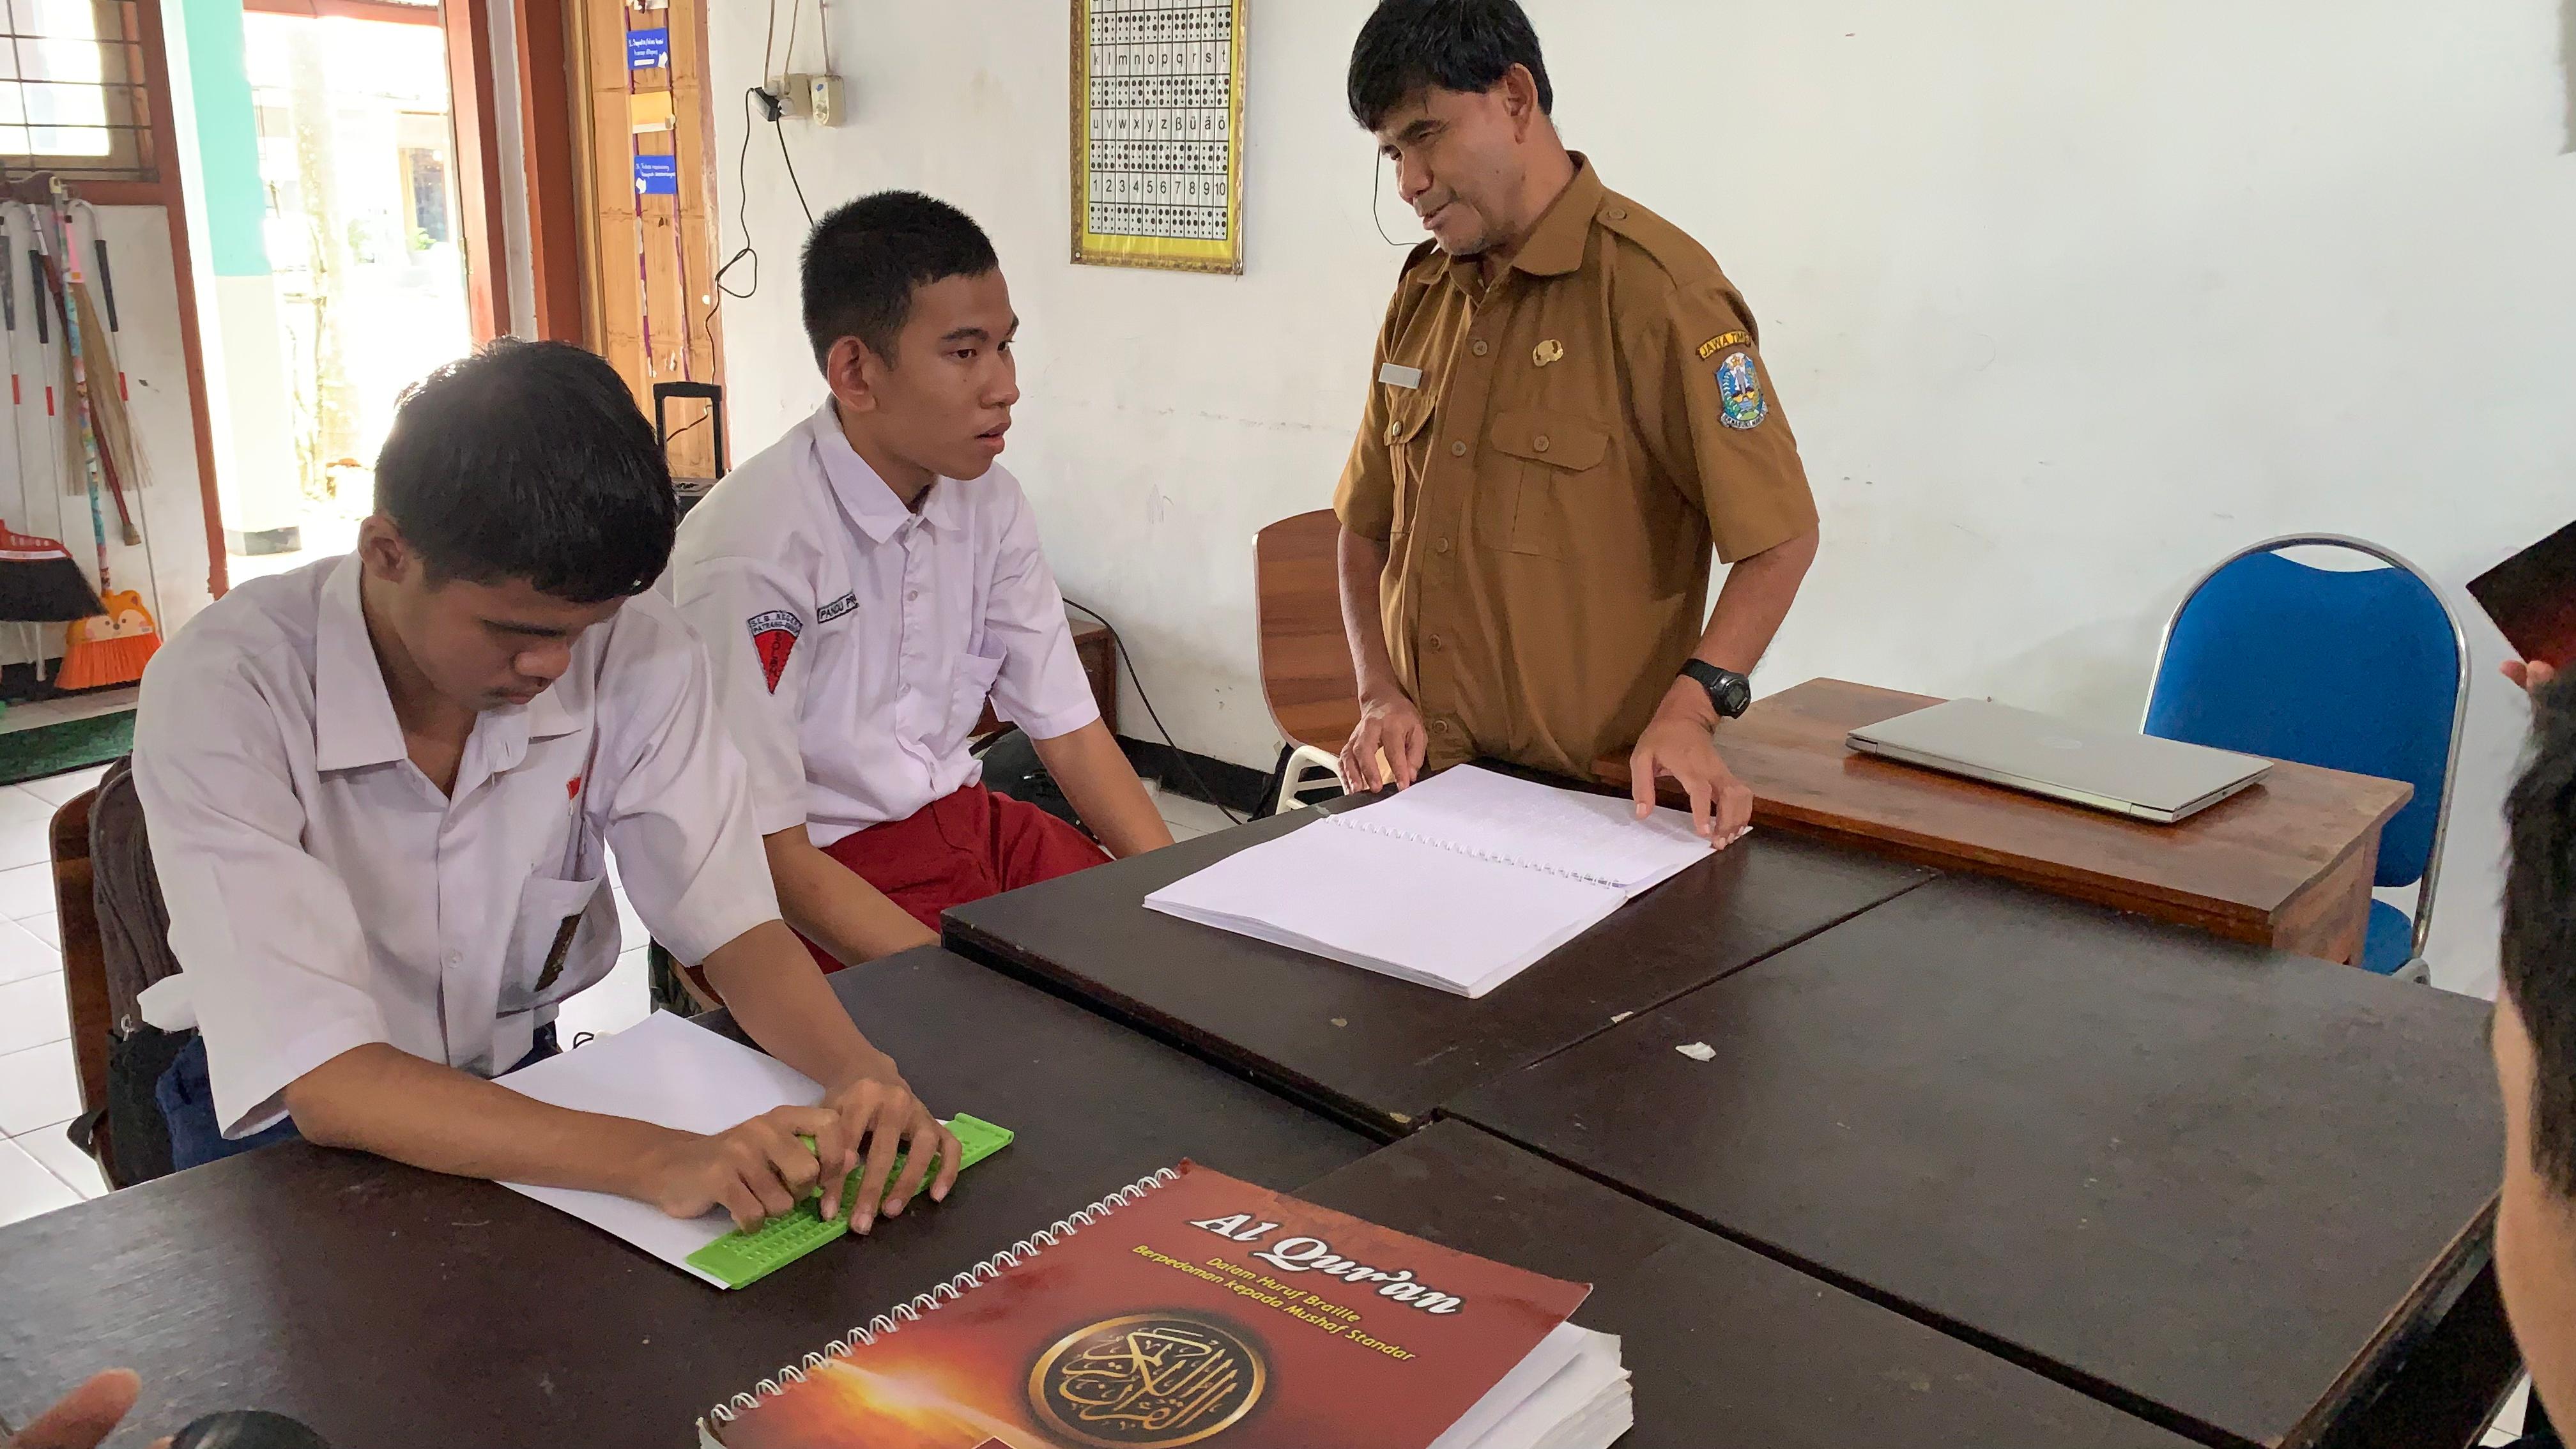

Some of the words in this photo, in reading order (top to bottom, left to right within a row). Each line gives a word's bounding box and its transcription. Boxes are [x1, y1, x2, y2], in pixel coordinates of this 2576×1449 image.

[1094, 53, 1099, 65] k
[1118, 54, 1128, 65] m
[1134, 54, 1140, 65] n
[1148, 54, 1154, 65] o
[1162, 54, 1168, 67] p
[1177, 54, 1183, 67] q
[1192, 53, 1197, 63] r
[1206, 52, 1212, 63] s
[1222, 50, 1226, 62] t
[1093, 119, 1099, 129] u
[1107, 119, 1112, 128] v
[1118, 119, 1127, 129] w
[1133, 119, 1140, 130] x
[1147, 119, 1154, 132] y
[1161, 119, 1167, 130] z
[1190, 116, 1197, 130] ü
[1204, 116, 1211, 130] ä
[1218, 116, 1225, 130] ö
[1106, 180, 1112, 192] 2
[1119, 180, 1126, 192] 3
[1133, 180, 1139, 192] 4
[1147, 181, 1153, 194] 5
[1160, 181, 1167, 194] 6
[1175, 181, 1181, 194] 7
[1189, 181, 1195, 195] 8
[1204, 182, 1210, 195] 9
[1215, 183, 1226, 195] 10
[1701, 335, 1729, 356] JAWA
[1190, 1214, 1278, 1241] Al
[1254, 1237, 1461, 1314] Qur'an
[1206, 1257, 1257, 1280] Dalam
[1256, 1276, 1308, 1300] Huruf
[1303, 1295, 1361, 1322] Braille
[1132, 1245, 1224, 1283] Berpedoman
[1223, 1280, 1284, 1308] kepada
[1284, 1305, 1350, 1334] Mushaf
[1345, 1330, 1416, 1360] Standar
